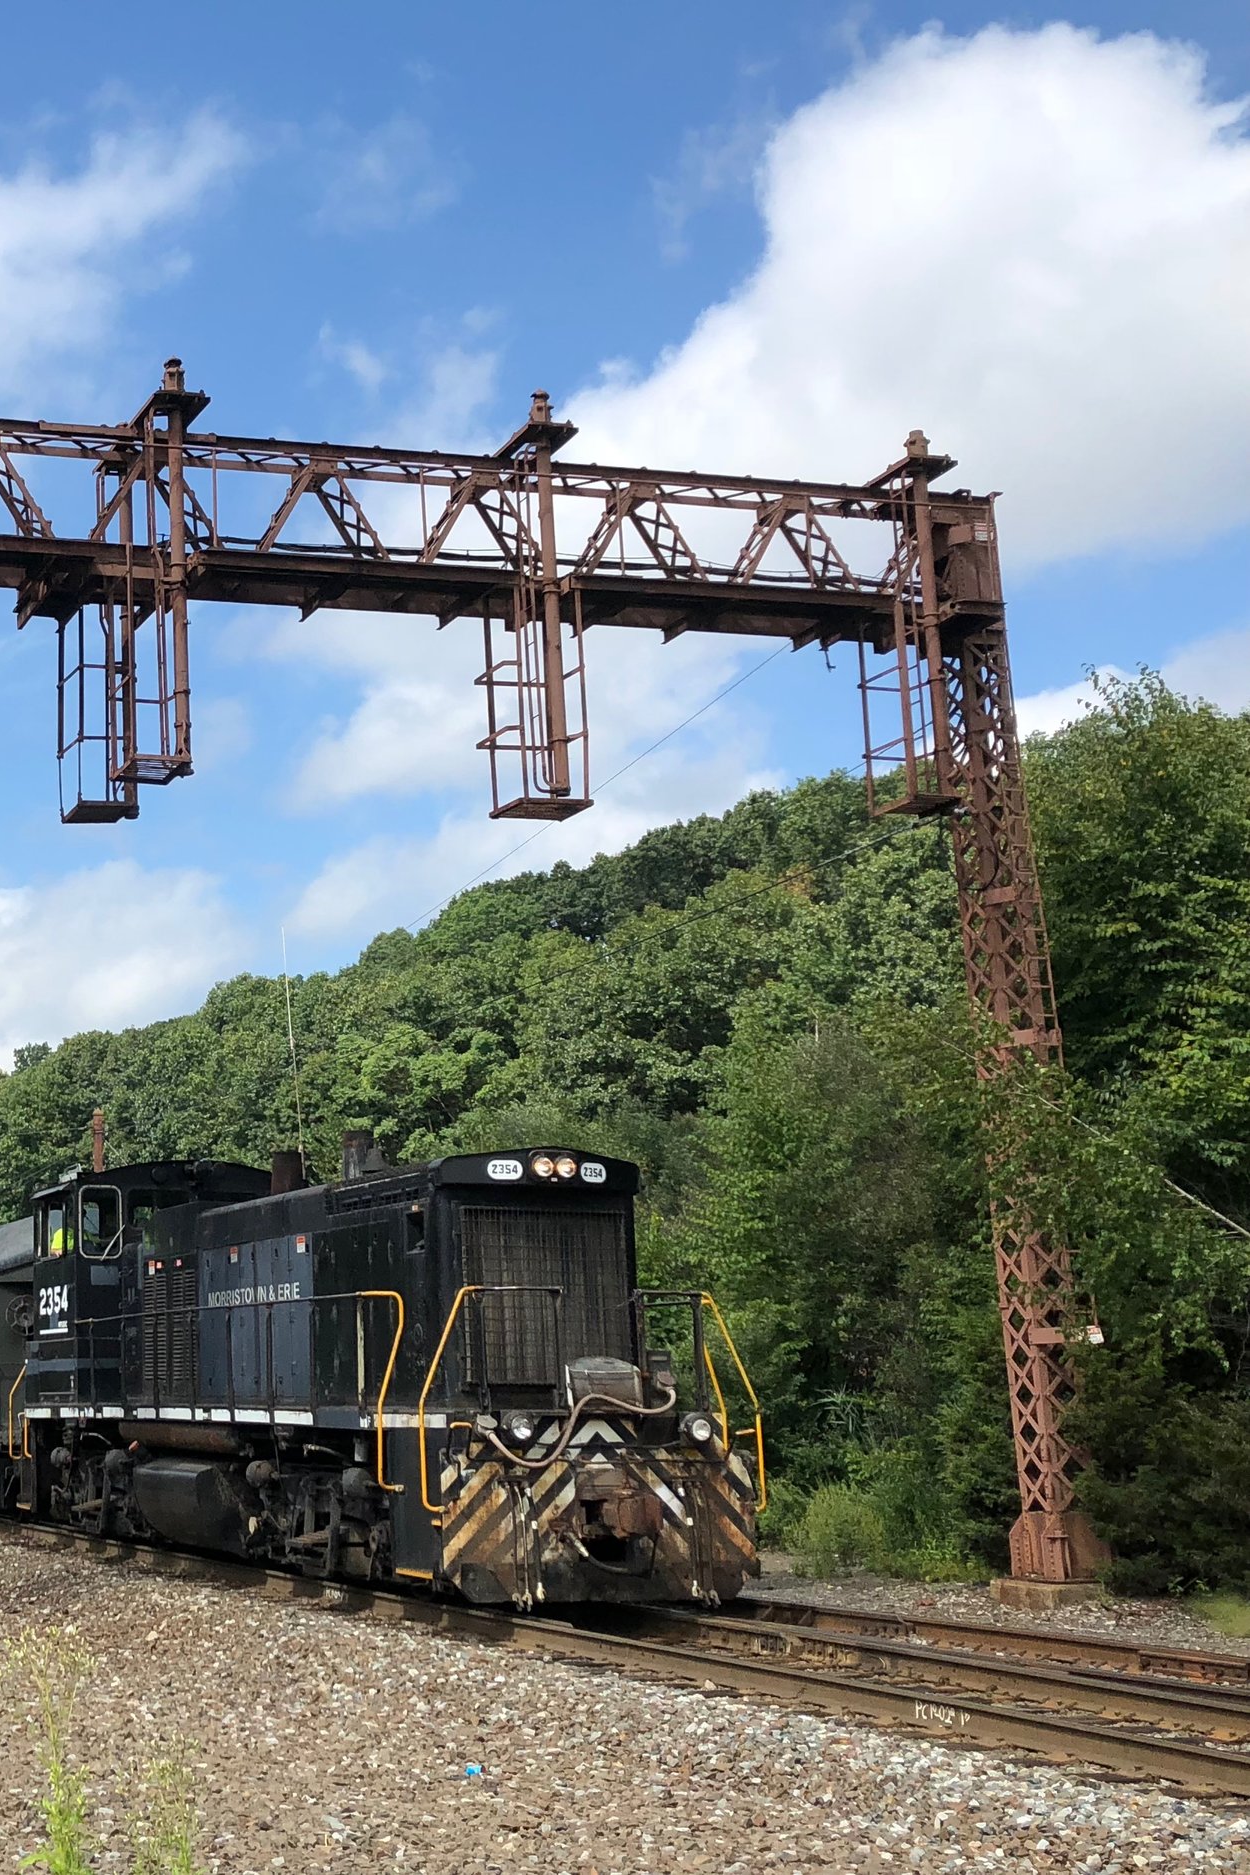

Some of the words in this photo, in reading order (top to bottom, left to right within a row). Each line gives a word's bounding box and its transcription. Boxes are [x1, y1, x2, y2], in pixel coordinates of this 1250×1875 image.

[491, 1164, 518, 1174] 2354
[583, 1166, 603, 1179] 2354
[268, 1284, 276, 1301] &
[277, 1281, 300, 1300] ERIE
[39, 1284, 68, 1316] 2354
